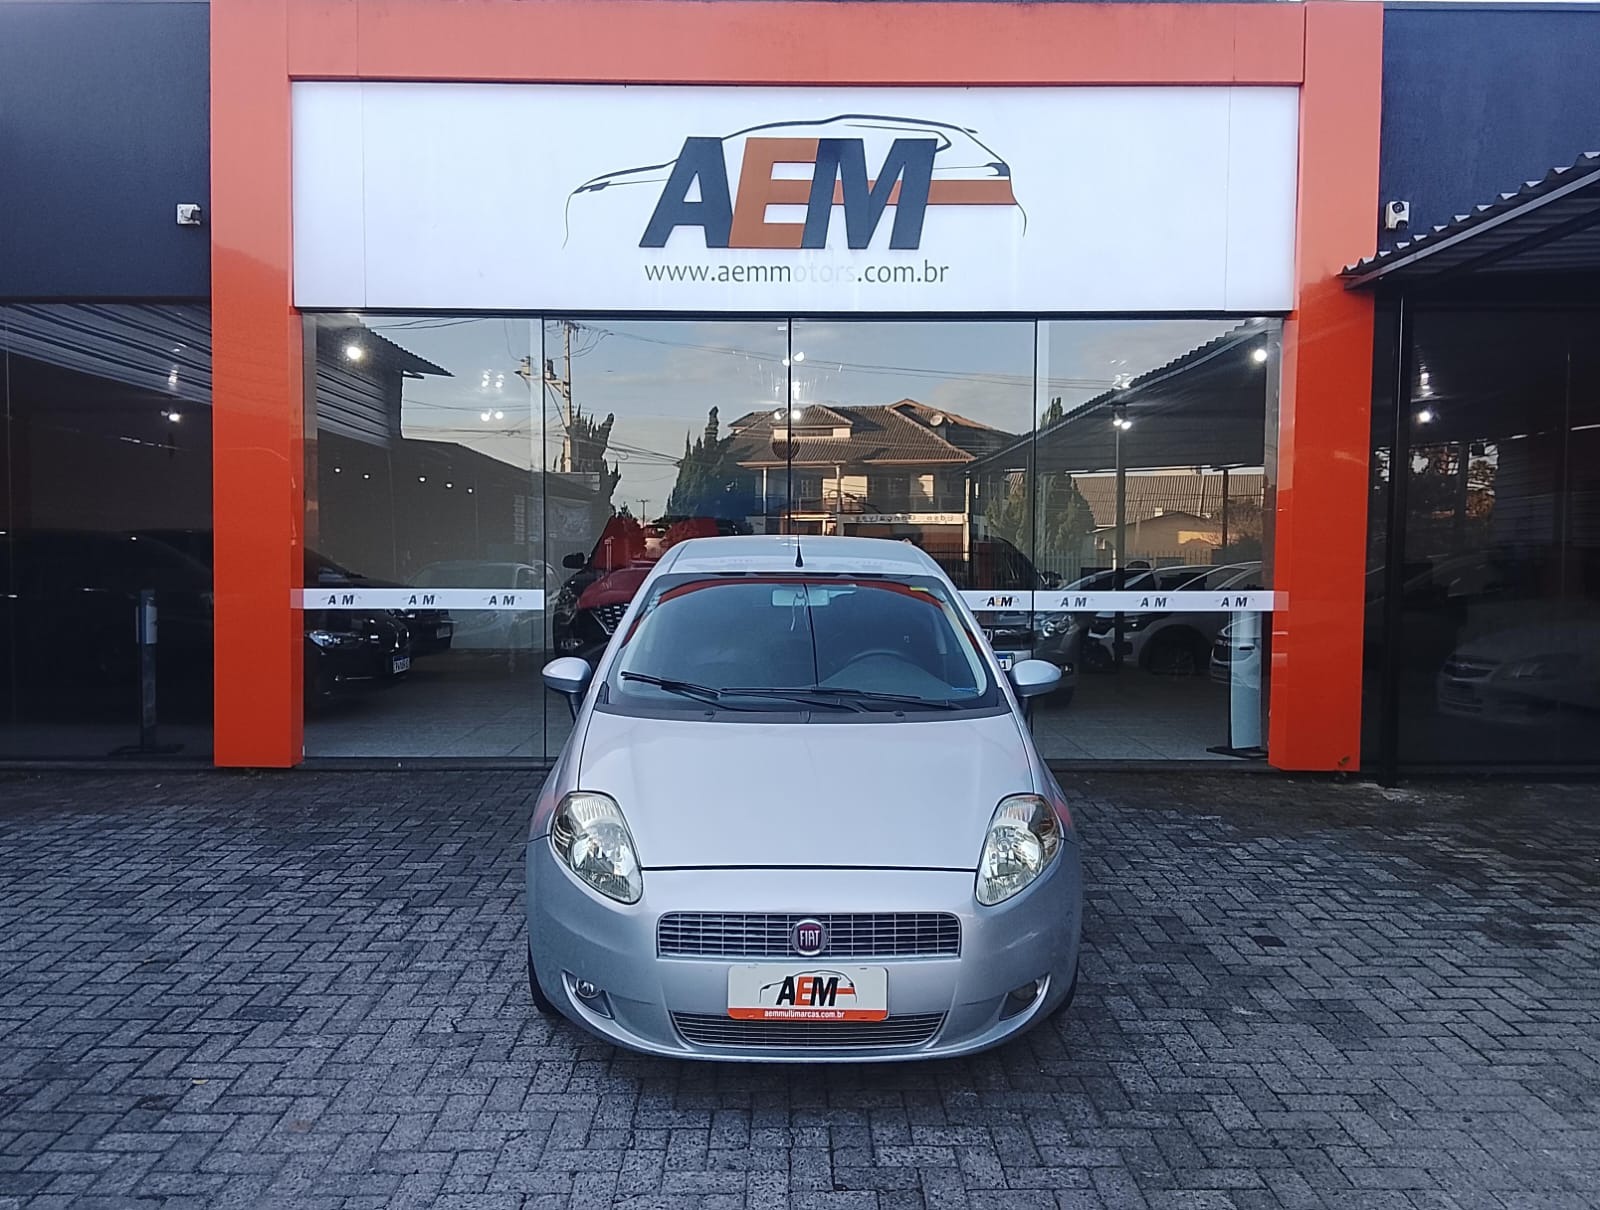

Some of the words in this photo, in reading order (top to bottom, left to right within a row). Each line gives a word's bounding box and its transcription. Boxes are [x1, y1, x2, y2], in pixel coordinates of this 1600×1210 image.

[639, 136, 938, 250] AEM
[800, 930, 820, 947] FIAT
[775, 976, 839, 1006] AEM
[764, 1009, 845, 1019] aemmultimarcas.com.br
